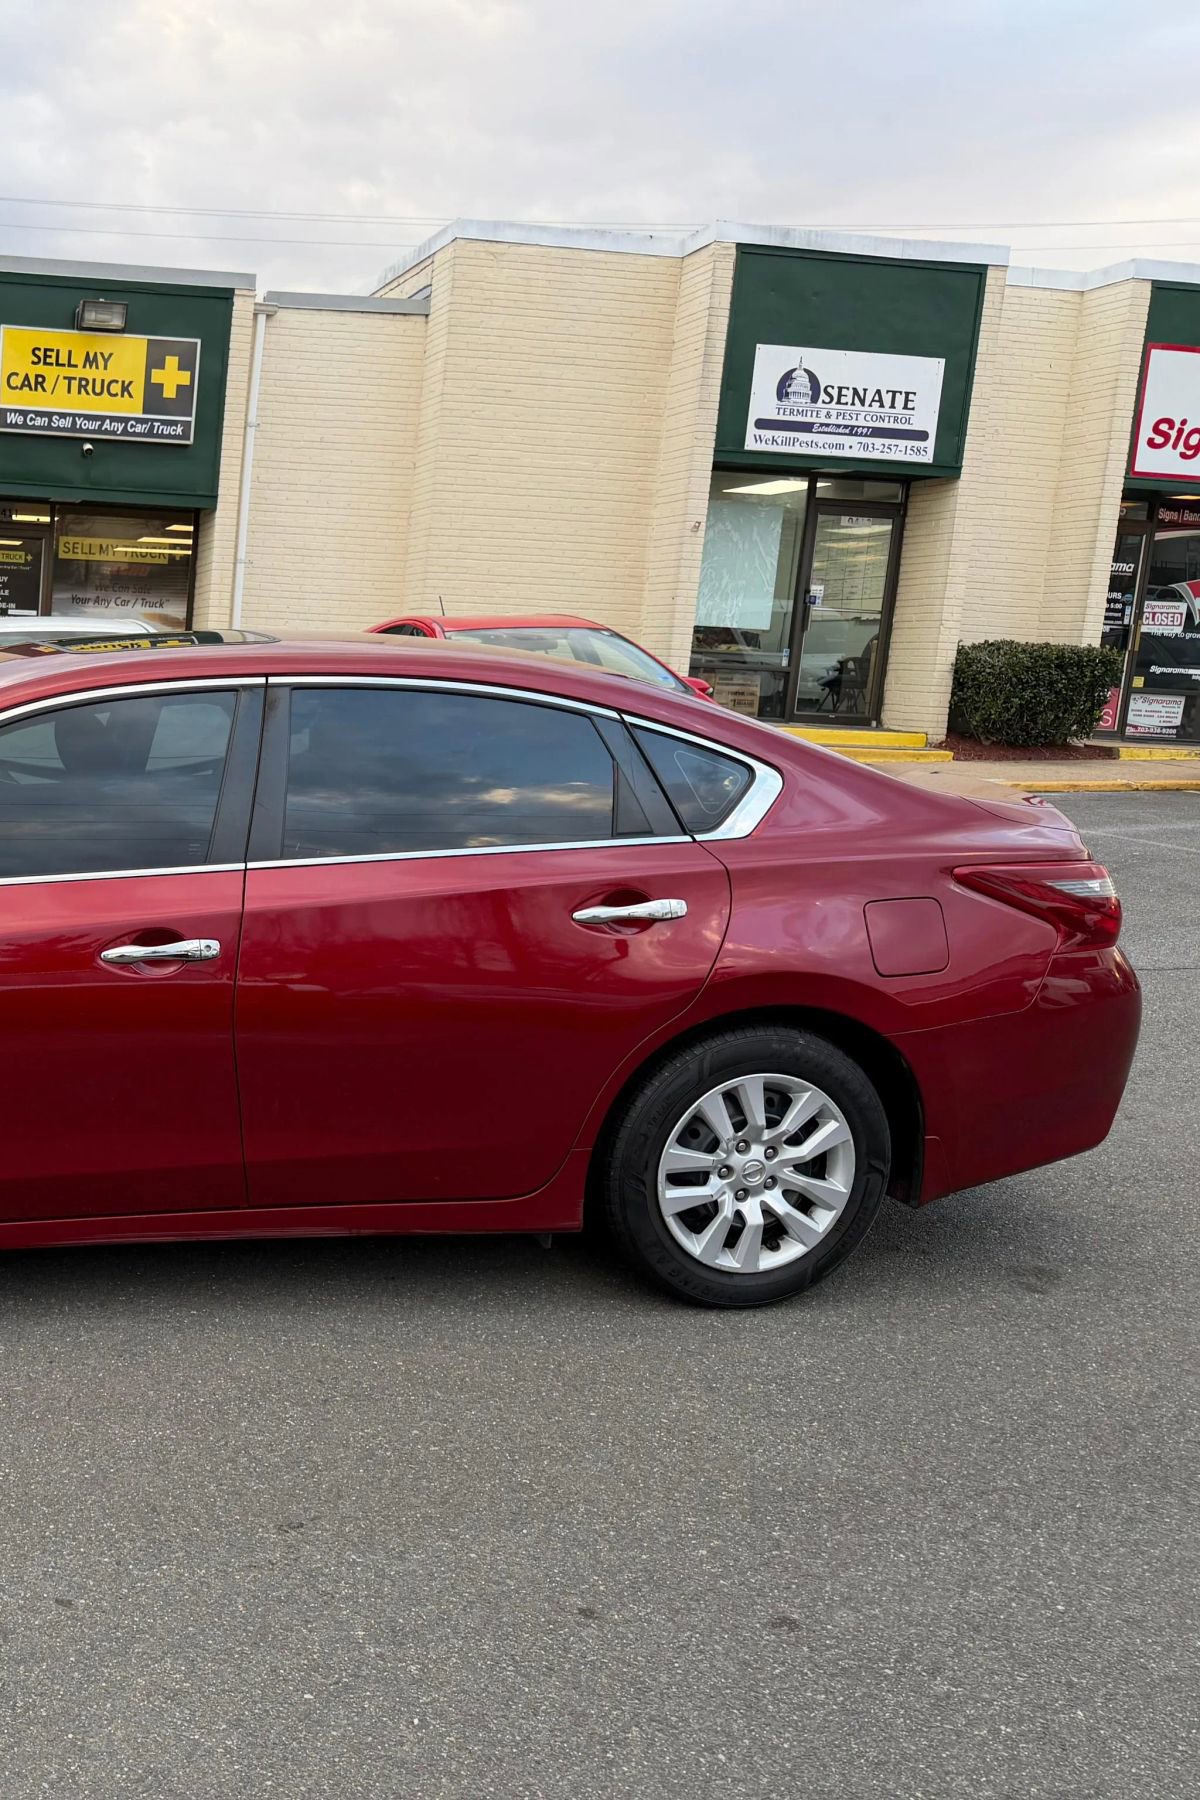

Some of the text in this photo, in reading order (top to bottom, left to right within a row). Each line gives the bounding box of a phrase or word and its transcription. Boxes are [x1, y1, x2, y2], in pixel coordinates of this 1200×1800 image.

[31, 346, 114, 371] SELL MY
[63, 375, 134, 399] TRUCK
[821, 384, 917, 411] SENATE
[6, 412, 24, 424] We
[27, 413, 49, 426] Can
[51, 415, 72, 428] Sell
[75, 416, 101, 431] Your
[102, 418, 124, 434] Any
[153, 422, 184, 436] Truck
[775, 406, 913, 426] TERMITE & PEST CONTROL
[812, 423, 872, 436] Established 1991
[1147, 417, 1200, 460] Sig
[753, 434, 928, 457] WeKillPests.com 703-257-1585
[1158, 507, 1178, 522] Signs
[0, 553, 23, 561] TRUCK
[62, 541, 166, 560] SELL MY TRUCK
[71, 594, 91, 605] Your
[93, 595, 112, 609] Any
[114, 596, 130, 607] Car
[1142, 612, 1181, 626] CLOSED
